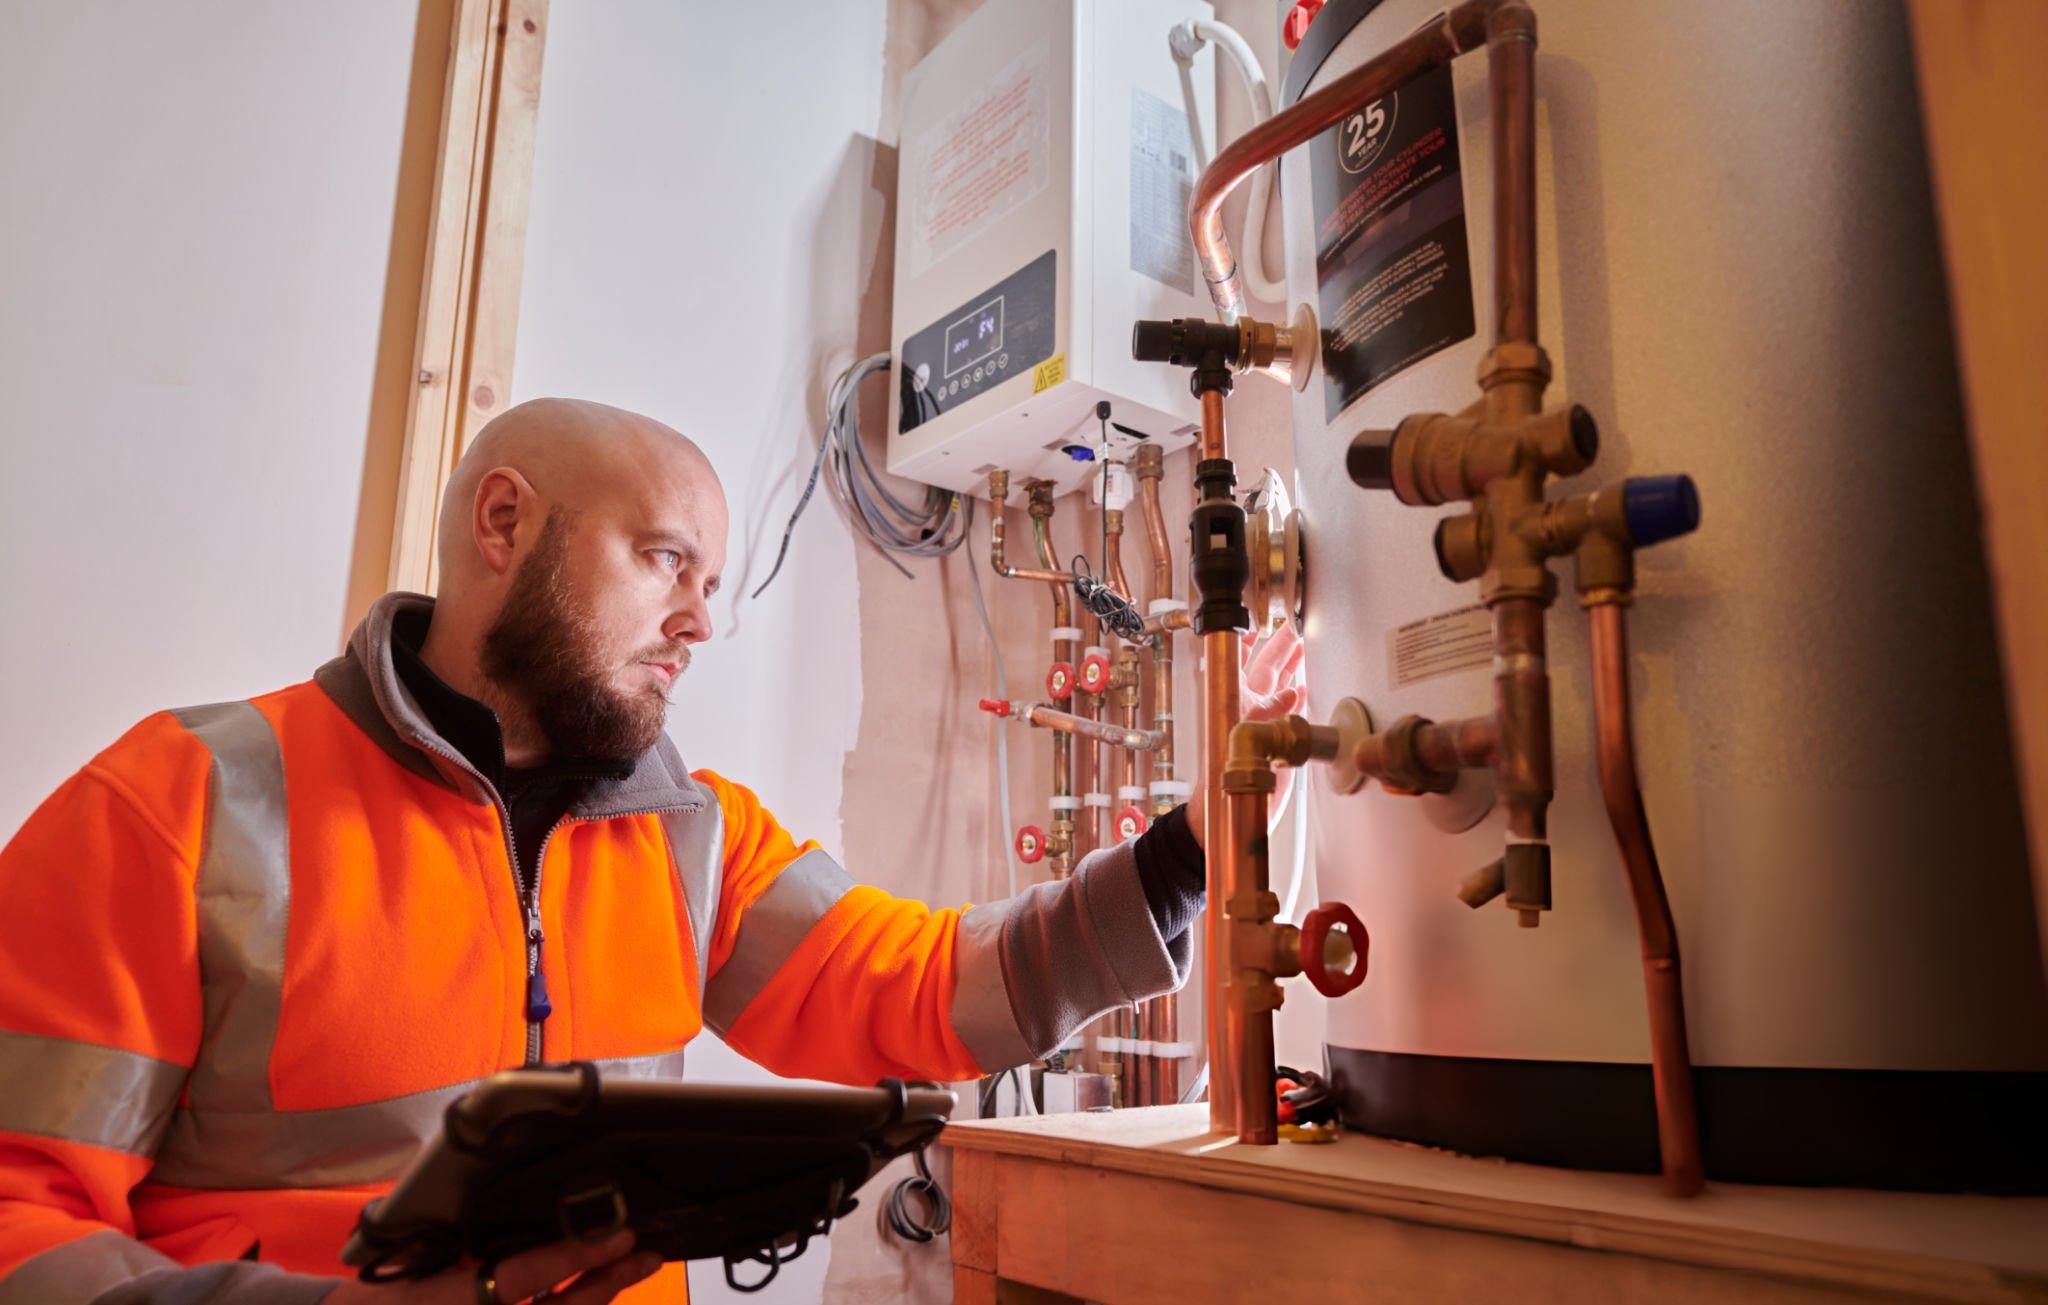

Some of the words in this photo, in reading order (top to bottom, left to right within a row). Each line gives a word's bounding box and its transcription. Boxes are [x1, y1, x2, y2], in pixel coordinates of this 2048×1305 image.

[1347, 99, 1386, 158] 25
[1358, 138, 1378, 158] YEAR
[1372, 158, 1395, 180] YOUR
[1396, 127, 1445, 162] CYLINDER
[1379, 155, 1418, 185] ACTIVATE
[1420, 136, 1447, 158] YOUR
[1364, 172, 1411, 210] WARRANTY
